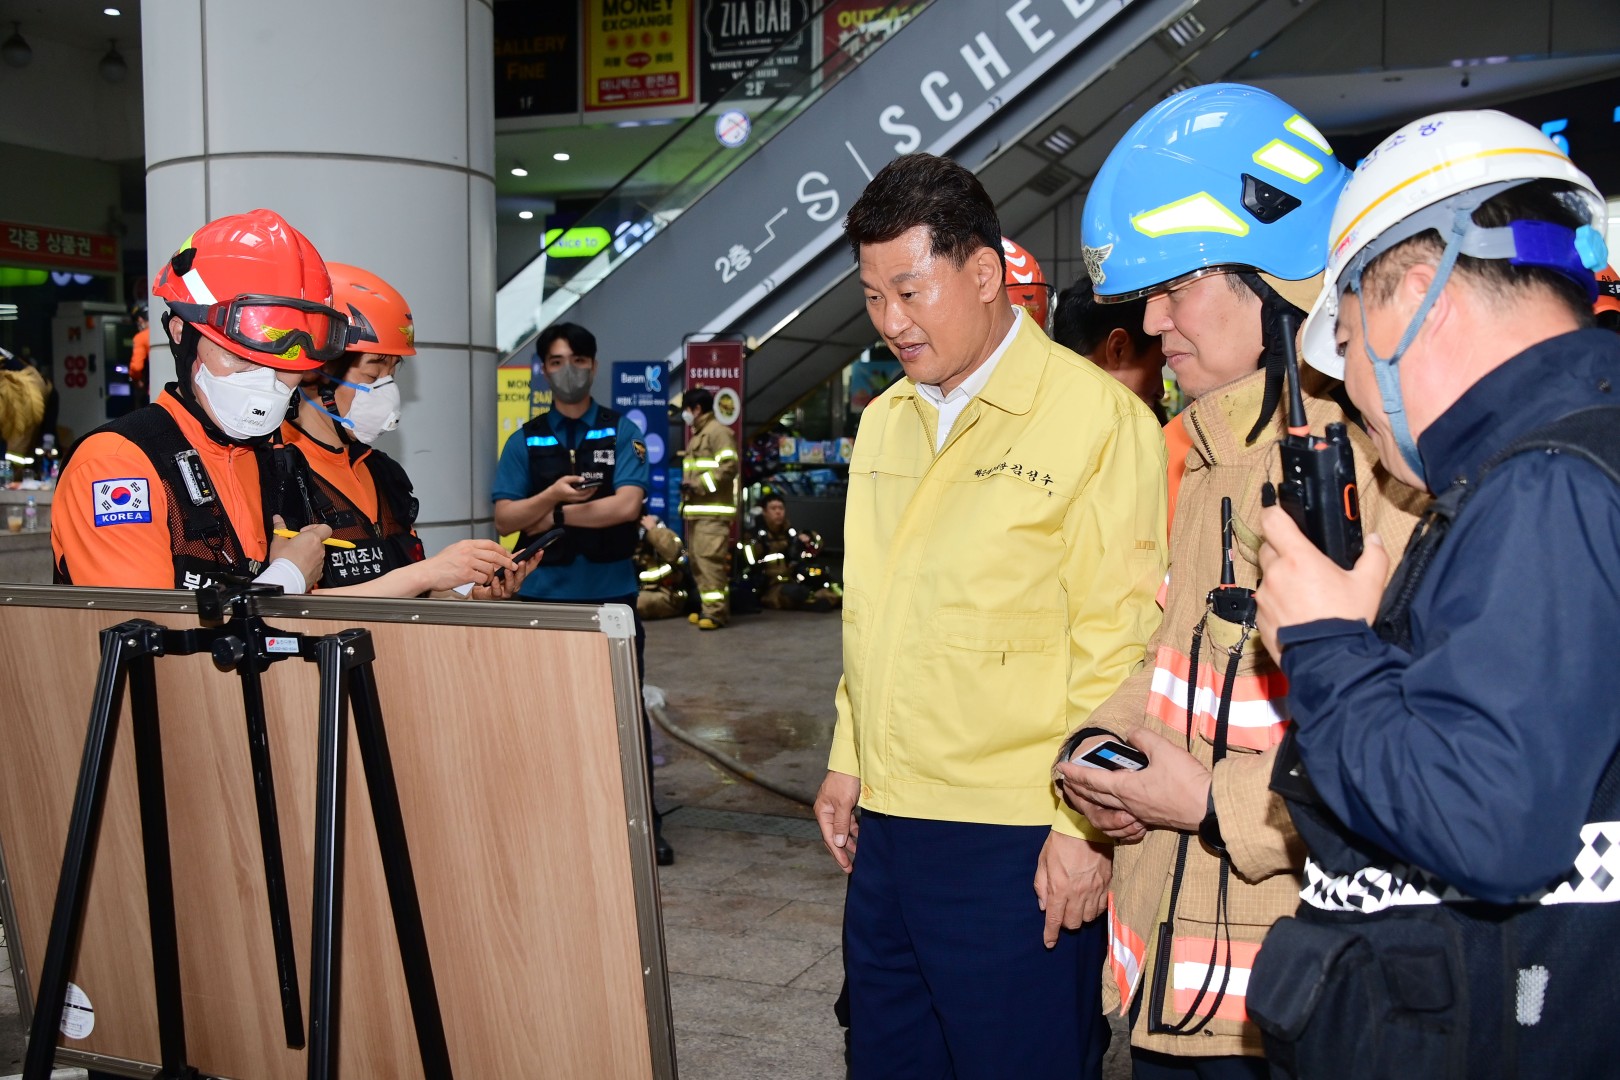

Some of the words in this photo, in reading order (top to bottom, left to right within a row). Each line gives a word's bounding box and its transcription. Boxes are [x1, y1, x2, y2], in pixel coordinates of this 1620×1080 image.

[602, 0, 673, 17] MONEY
[602, 15, 673, 32] EXCHANGE
[720, 2, 750, 37] ZIA
[755, 0, 791, 33] BAR
[745, 80, 766, 97] 2F
[8, 228, 40, 251] 각종
[47, 233, 92, 257] 상품권
[715, 243, 753, 283] 2층
[690, 367, 740, 379] SCHEDULE
[252, 408, 266, 417] 3M
[1010, 463, 1054, 486] 김성수
[101, 512, 143, 522] KOREA
[331, 546, 384, 567] 화재조사
[339, 563, 381, 578] 부산소방
